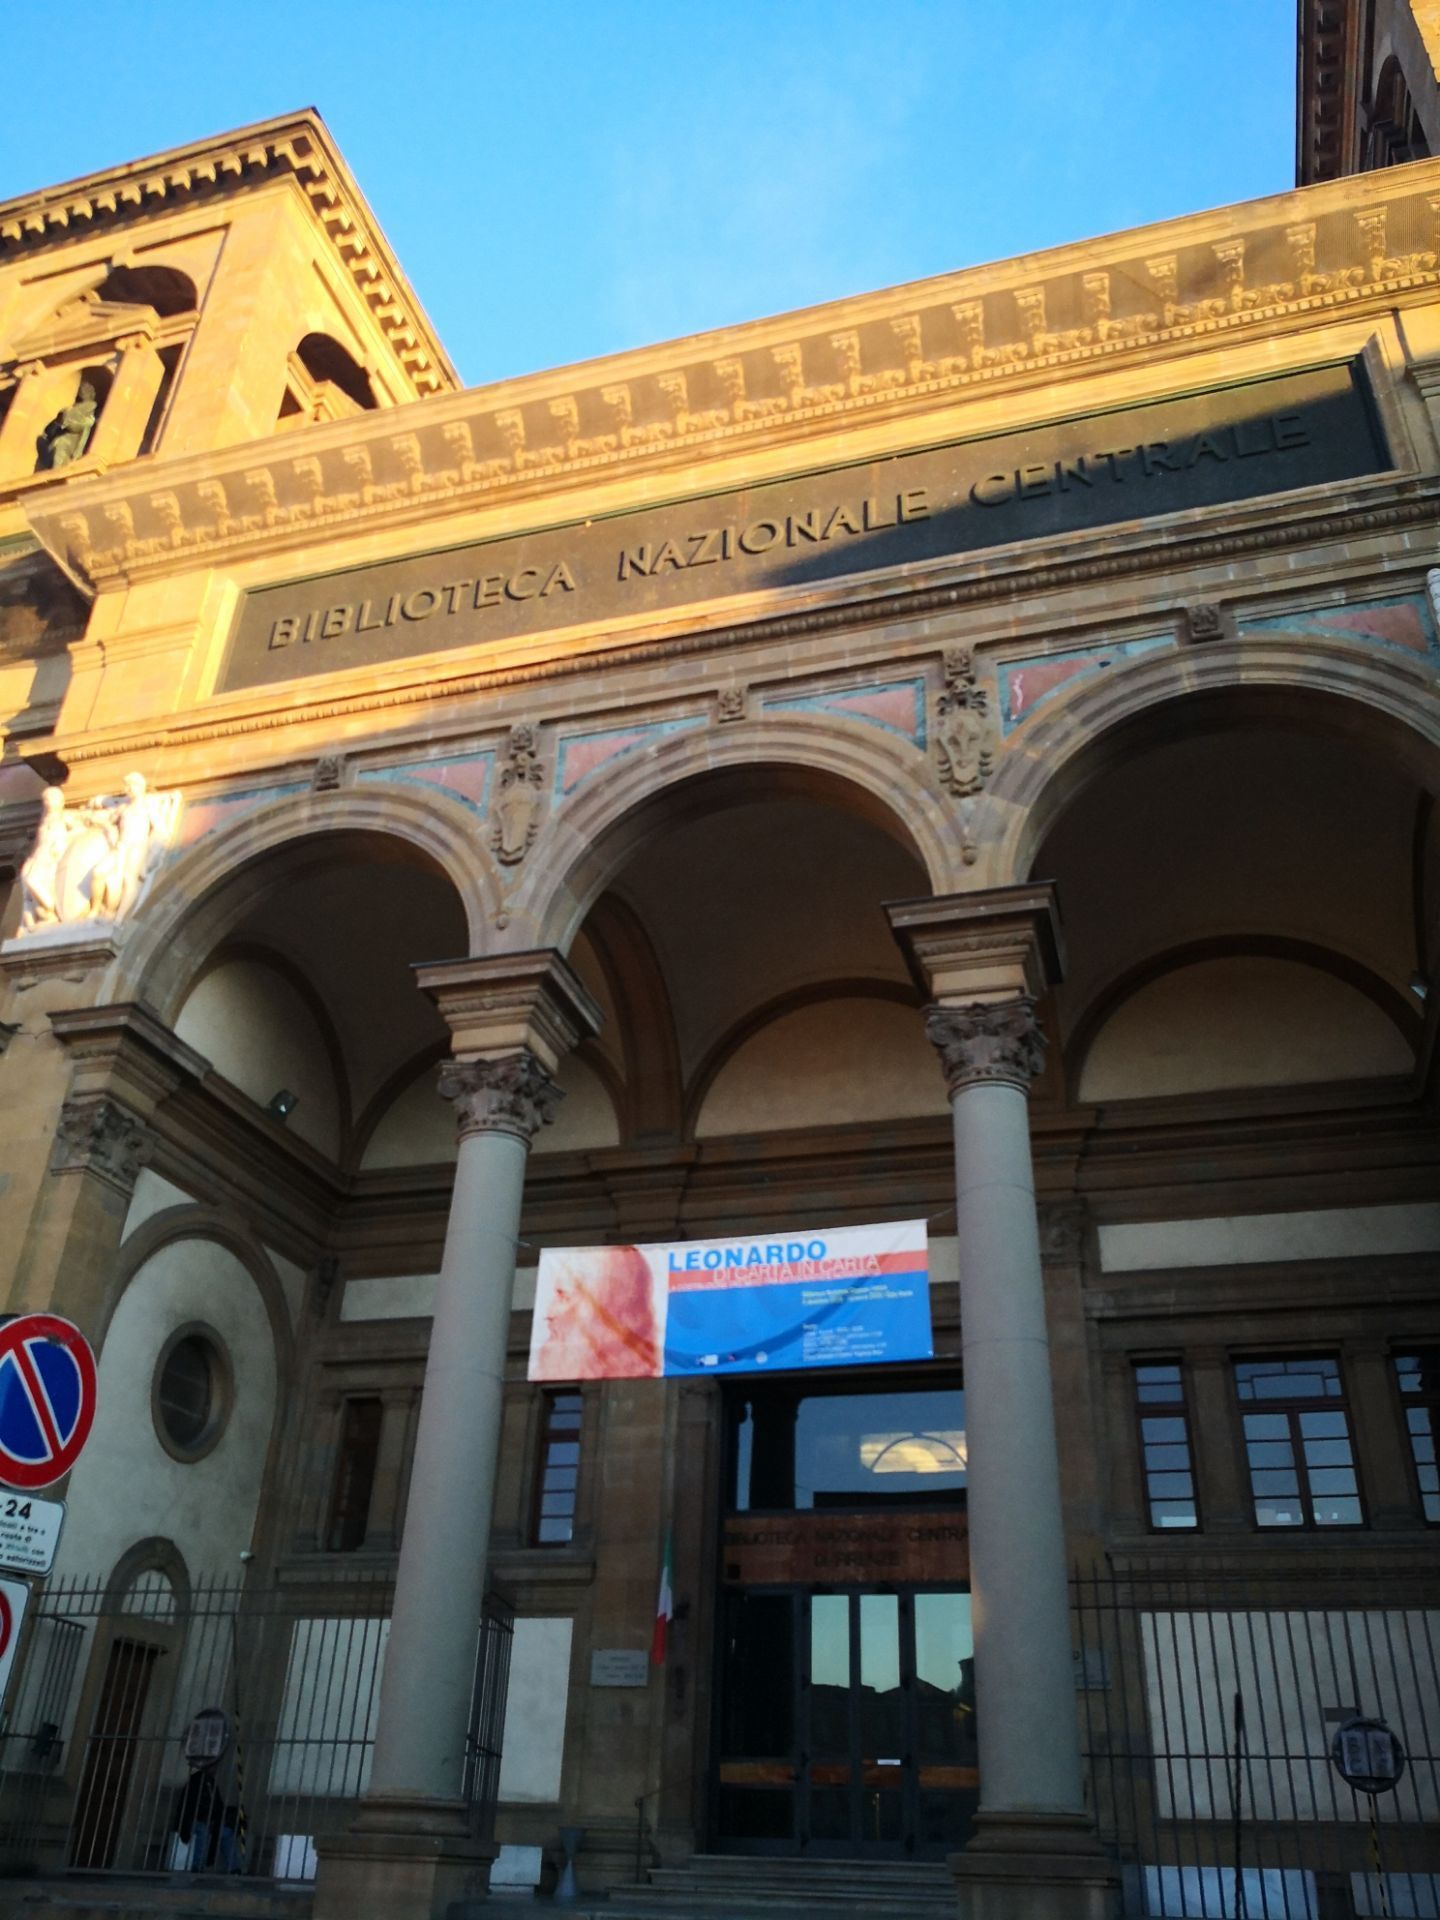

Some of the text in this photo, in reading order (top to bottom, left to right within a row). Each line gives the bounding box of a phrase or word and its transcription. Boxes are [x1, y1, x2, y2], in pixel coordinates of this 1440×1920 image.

[268, 414, 1312, 652] BIBLIOTECA NAZIONALE CENTRALE
[668, 1239, 827, 1272] LEONARDO
[713, 1254, 880, 1283] DI CARTA IN CARTA
